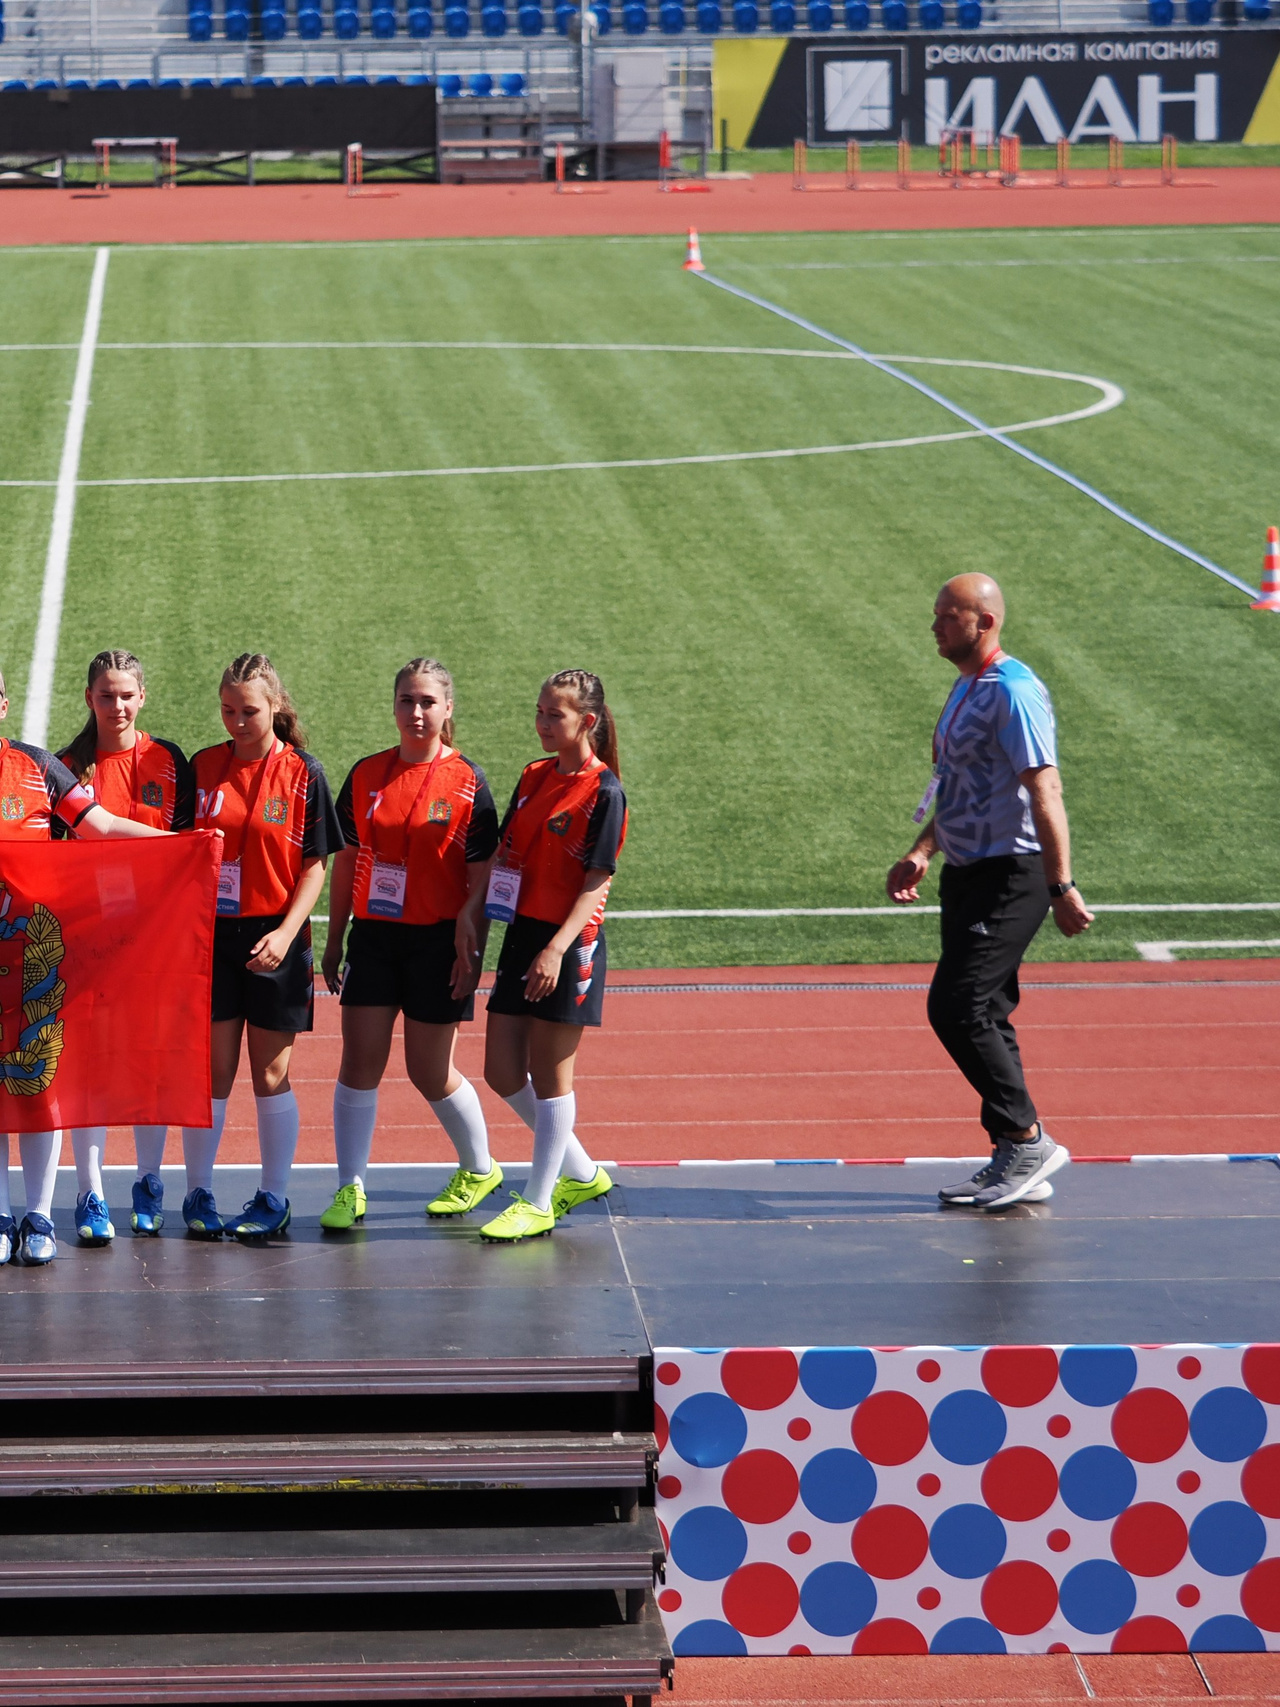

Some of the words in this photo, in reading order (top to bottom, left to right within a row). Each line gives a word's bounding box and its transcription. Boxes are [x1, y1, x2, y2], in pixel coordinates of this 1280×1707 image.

[925, 42, 1079, 70] рекламная
[1085, 39, 1218, 61] компания
[924, 74, 1219, 145] ИЛАН
